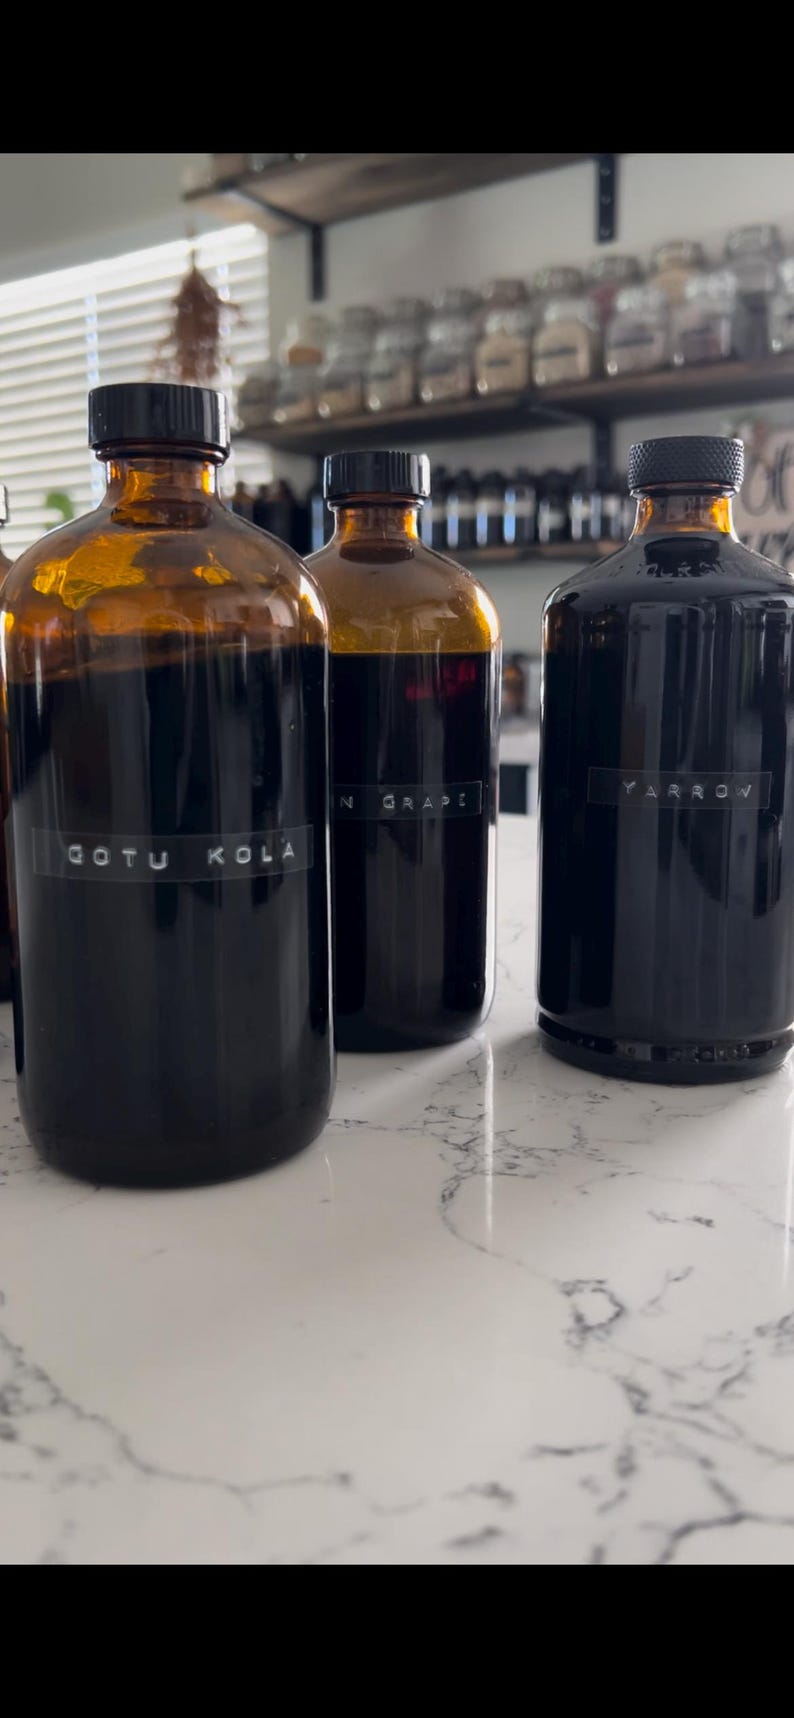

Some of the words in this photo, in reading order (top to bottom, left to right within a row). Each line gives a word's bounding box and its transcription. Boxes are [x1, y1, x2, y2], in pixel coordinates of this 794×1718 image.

[622, 780, 752, 799] YARROW
[382, 793, 467, 810] GRAPE
[67, 843, 169, 871] GOTU
[206, 841, 296, 866] KOLA
